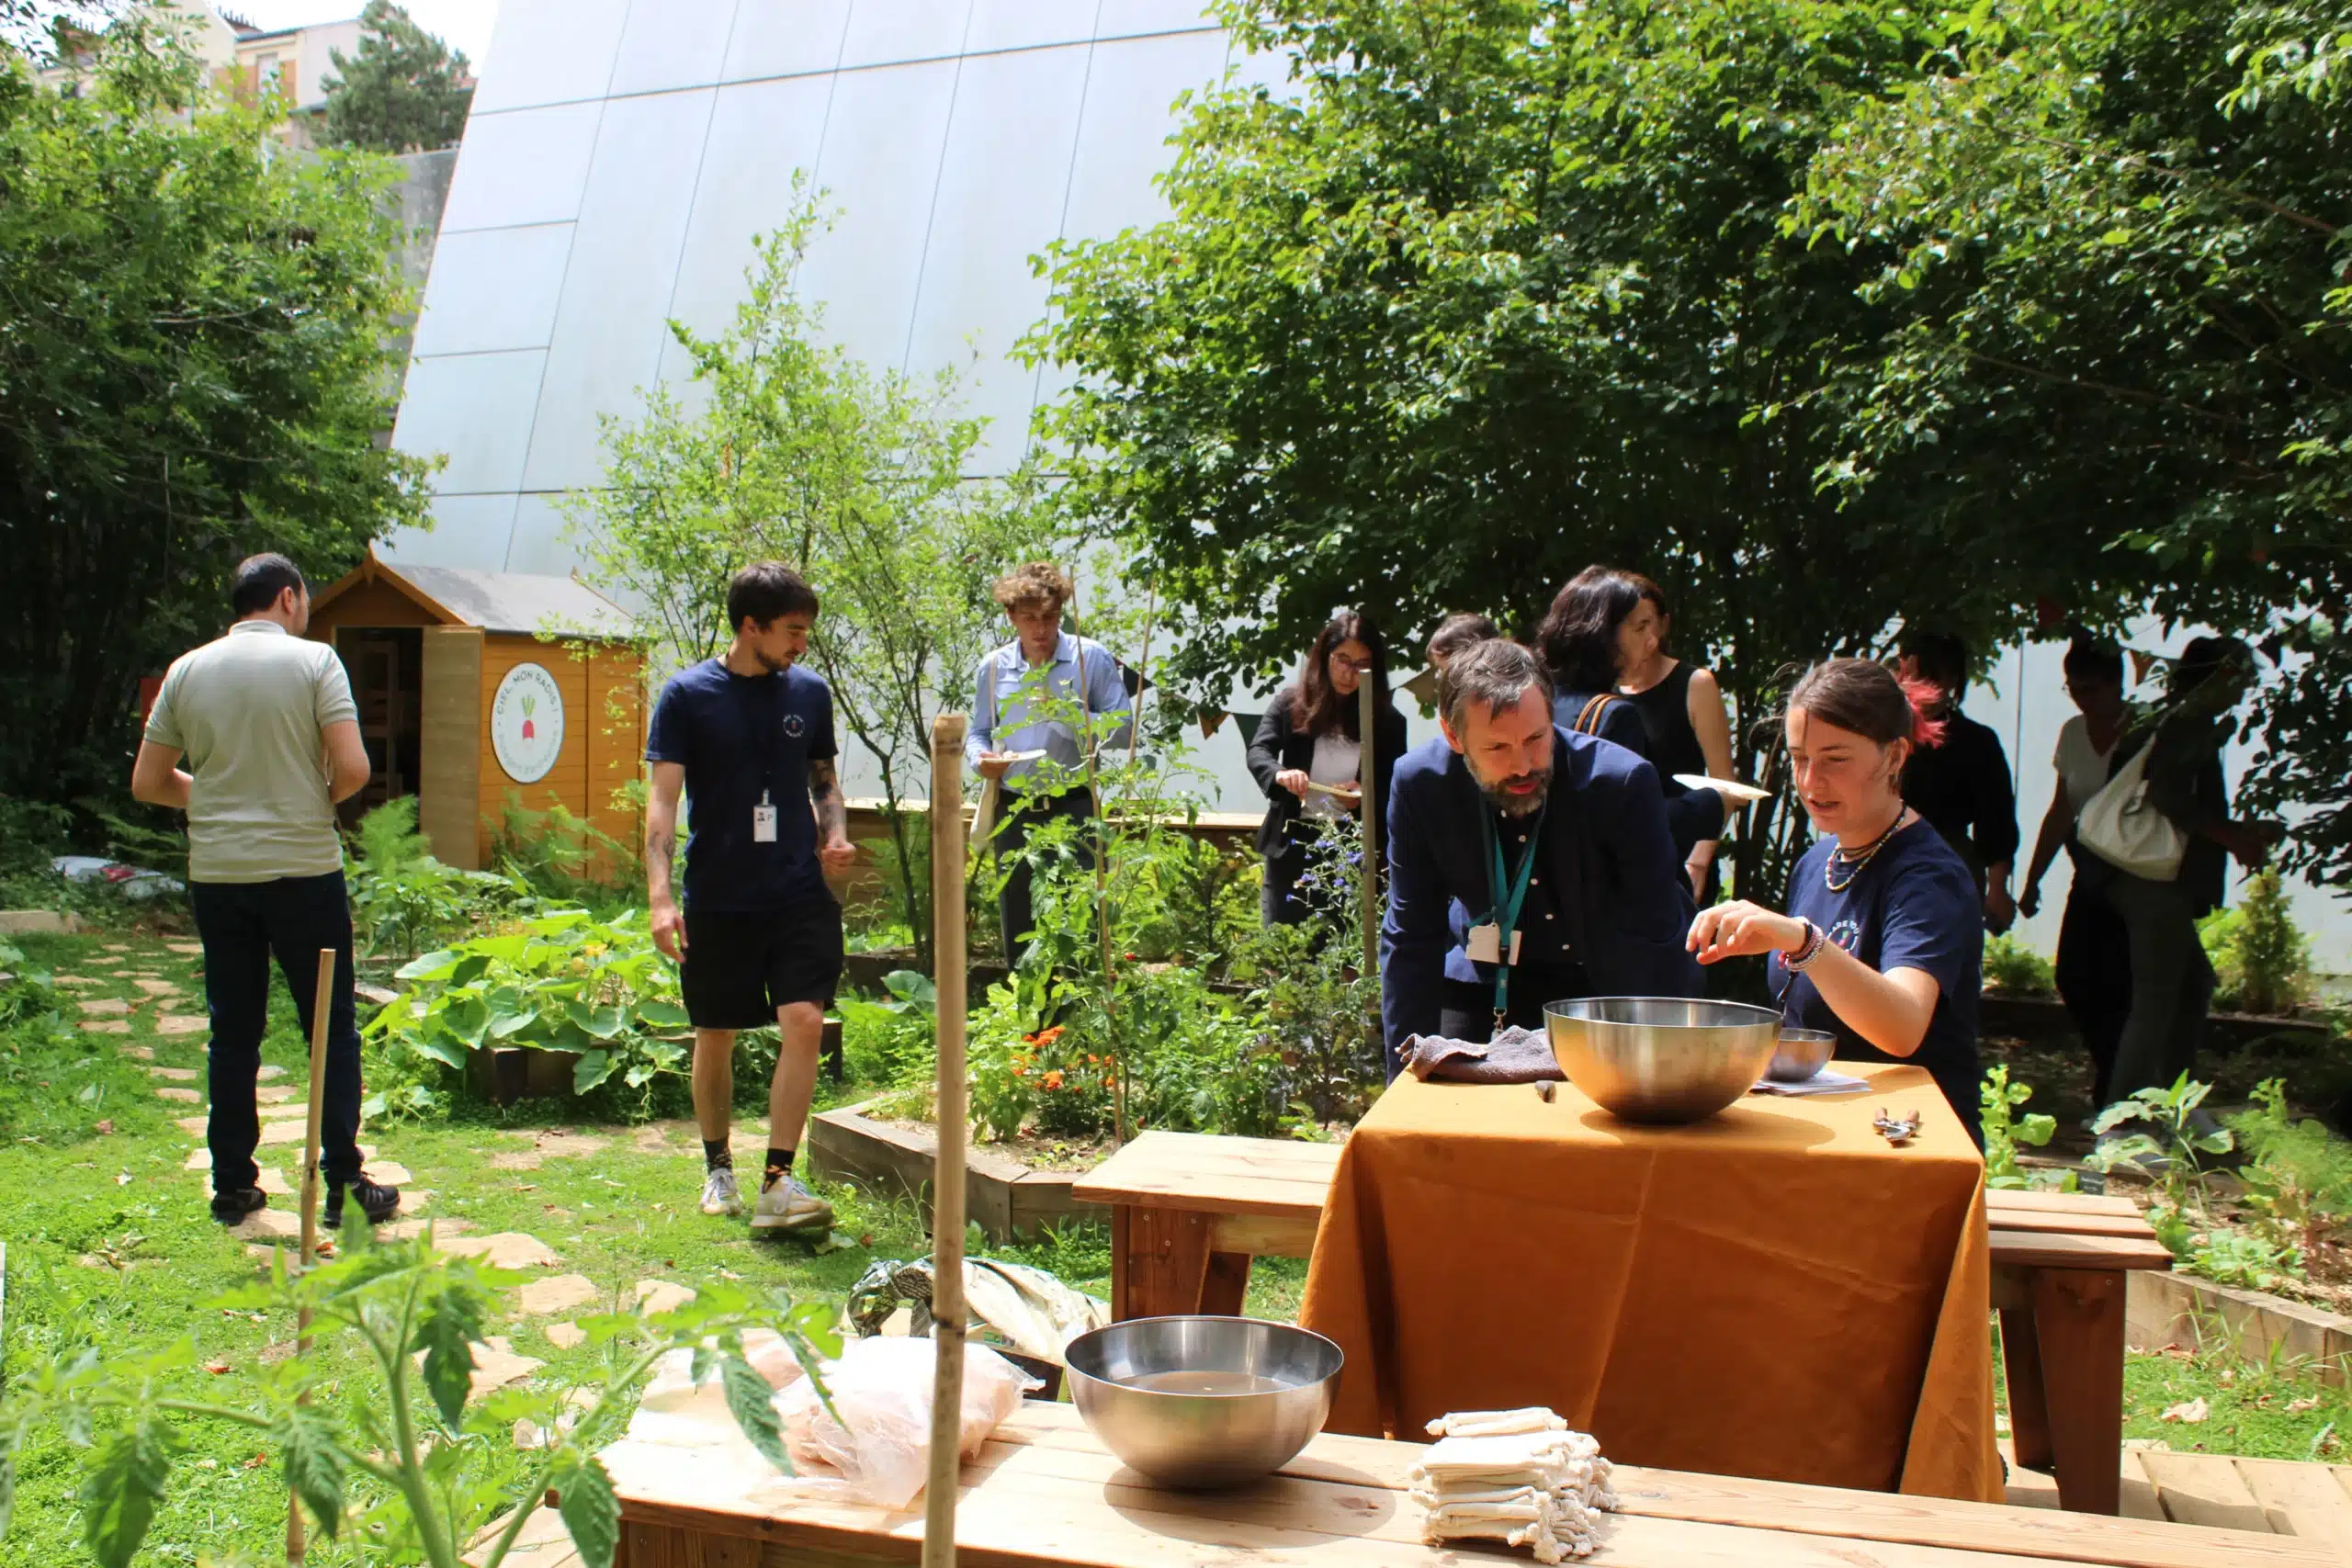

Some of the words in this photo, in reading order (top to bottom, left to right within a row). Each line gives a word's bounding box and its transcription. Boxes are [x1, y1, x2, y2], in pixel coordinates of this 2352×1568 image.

[513, 671, 533, 683] MON
[536, 673, 557, 705] RADIS
[1832, 920, 1849, 932] ARE
